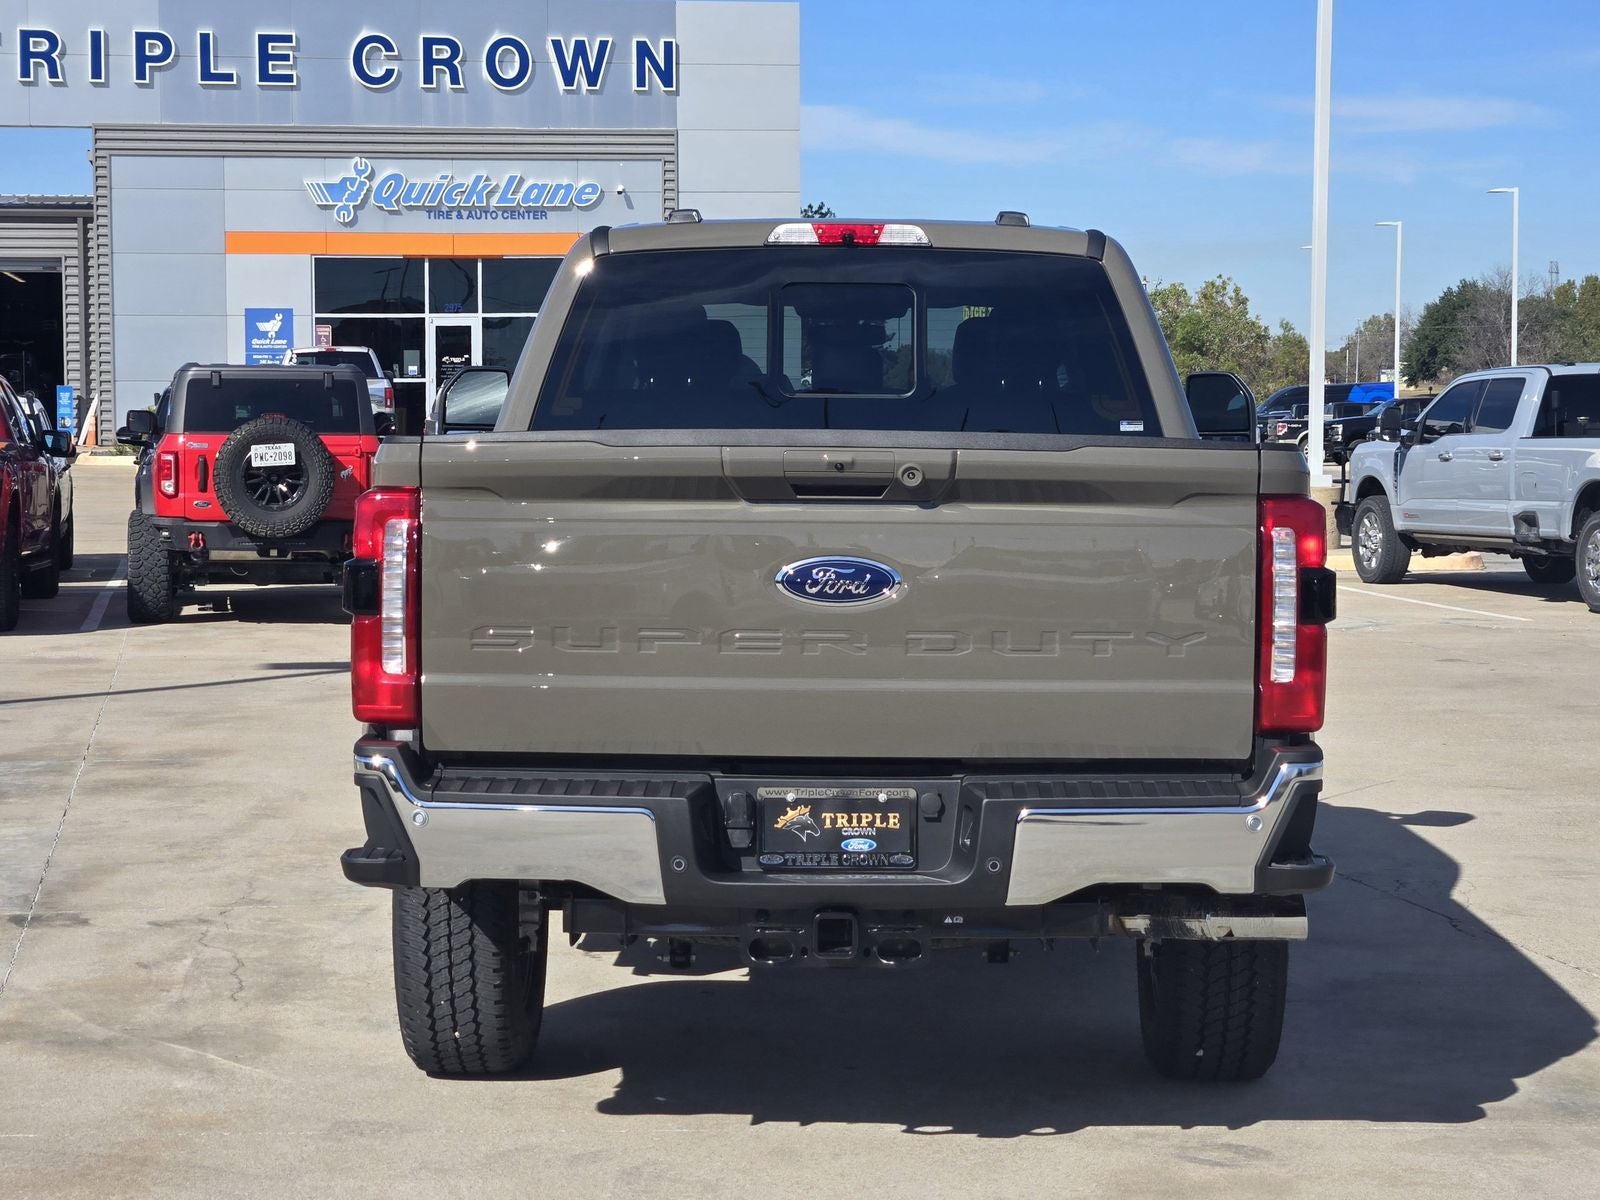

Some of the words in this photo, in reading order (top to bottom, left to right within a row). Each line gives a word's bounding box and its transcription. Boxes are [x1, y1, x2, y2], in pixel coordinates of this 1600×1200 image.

[17, 27, 298, 87] RIPLE
[350, 32, 677, 92] CROWN
[372, 173, 497, 210] Quick
[494, 174, 602, 207] Lane
[426, 210, 452, 220] TIRE
[455, 210, 464, 220] &
[466, 210, 498, 220] AUTO
[501, 210, 548, 220] CENTER
[805, 566, 871, 594] Ford
[471, 625, 868, 656] SUPER
[905, 630, 1207, 658] DUTY
[821, 812, 901, 829] TRIPLE
[841, 827, 876, 836] CROWN
[847, 840, 870, 850] Ford
[785, 853, 839, 866] TRIPLE
[842, 853, 889, 866] CROWN
